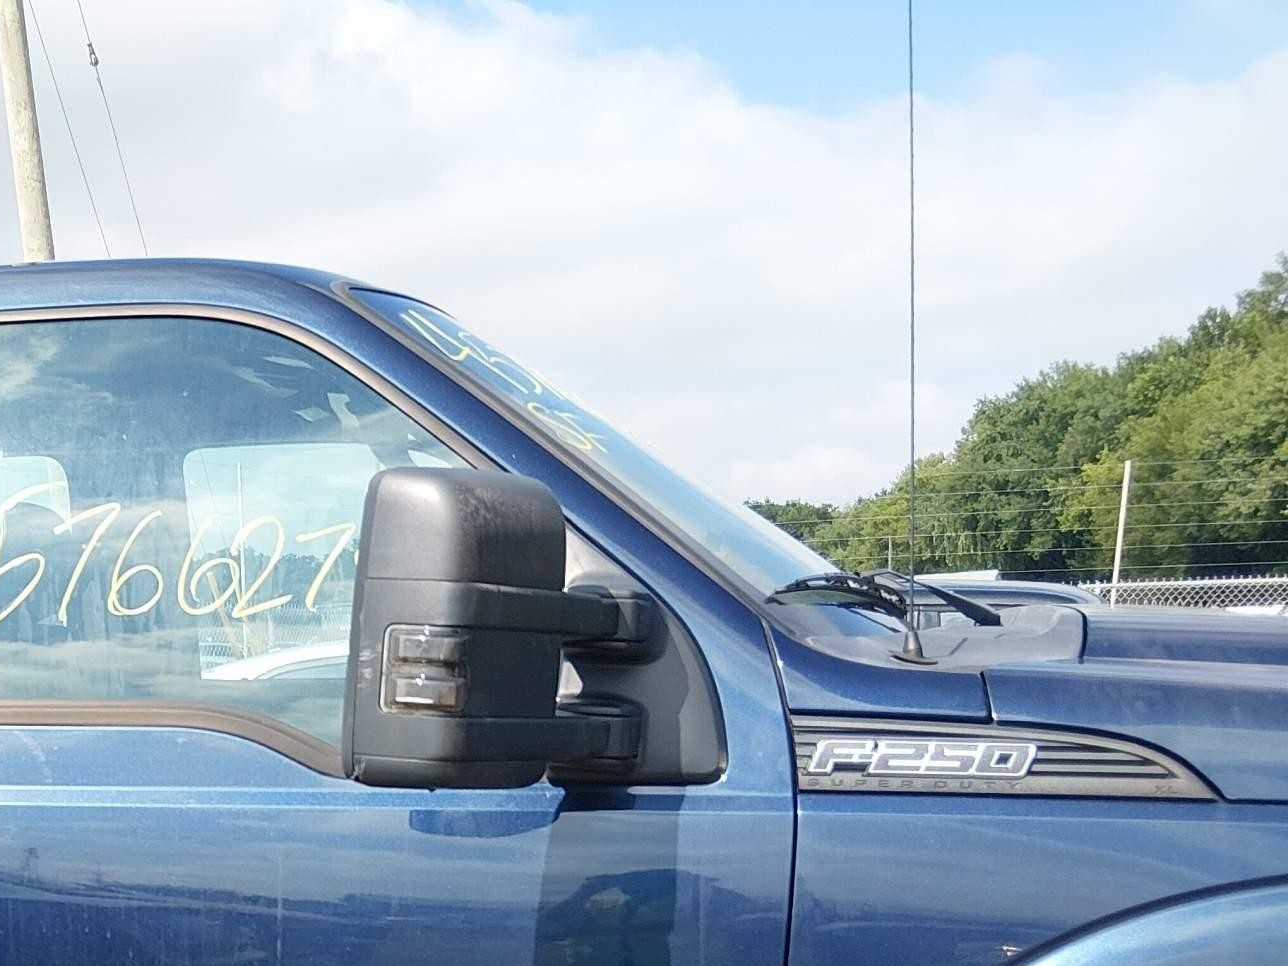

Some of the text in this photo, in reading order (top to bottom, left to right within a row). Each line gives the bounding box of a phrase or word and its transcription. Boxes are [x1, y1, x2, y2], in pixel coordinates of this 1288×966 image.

[808, 739, 1037, 779] F-250
[807, 778, 1021, 791] SUPER DUTY
